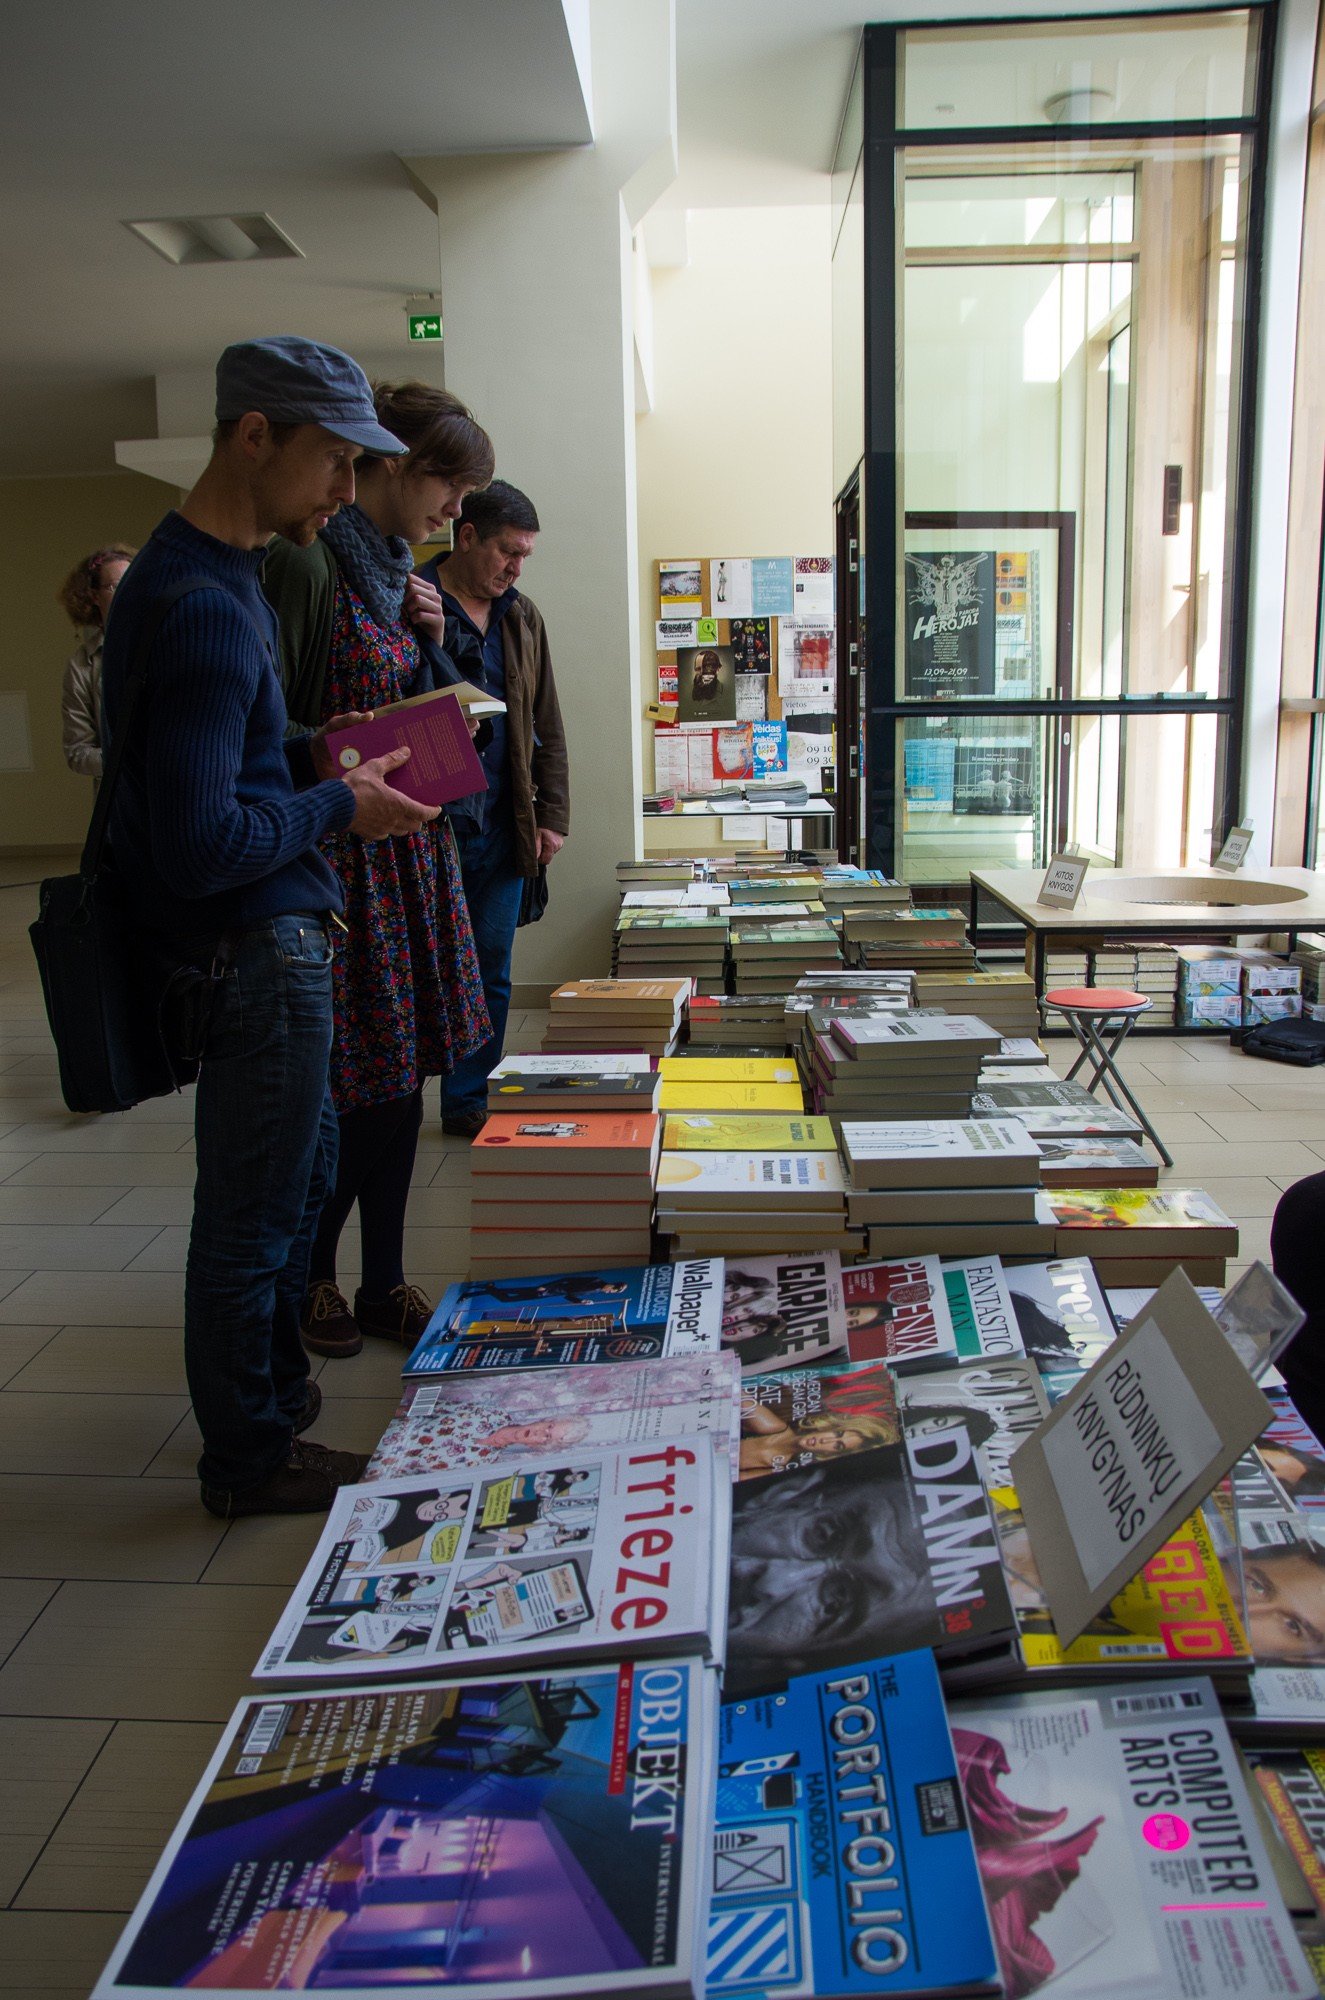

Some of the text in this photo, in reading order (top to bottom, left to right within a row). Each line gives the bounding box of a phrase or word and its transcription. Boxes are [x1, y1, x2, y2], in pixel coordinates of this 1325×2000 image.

[912, 612, 980, 641] HEROJAI
[806, 746, 820, 754] 09
[806, 757, 820, 765] 09
[1048, 880, 1075, 893] KNYGOS
[1055, 870, 1074, 881] KITOS
[651, 1265, 673, 1318] OPEN HOUSE
[777, 1262, 830, 1357] GARAGE
[946, 1292, 973, 1331] MAN
[967, 1265, 1014, 1353] FANTASTIC
[760, 1374, 781, 1406] KATE
[791, 1371, 807, 1421] DREAM GIRL
[804, 1369, 822, 1413] AMERICAN
[1105, 1359, 1182, 1503] RŪDNINKŲ
[1073, 1391, 1145, 1543] KNYGYNAS
[610, 1446, 696, 1631] frieze
[314, 1543, 349, 1604] THE FICTION ISSUE
[880, 1664, 899, 1699] THE
[299, 1703, 318, 1738] PARIS
[309, 1701, 347, 1788] RIJKSMUSEUM
[341, 1699, 375, 1785] DONALD JUDD
[360, 1697, 396, 1794] MARINA DEL REY
[405, 1695, 426, 1744] MILANO
[631, 1668, 683, 1834] OBJEKT
[1119, 1737, 1181, 1808] ARTS
[805, 1771, 832, 1880] HANDBOOK
[824, 1674, 909, 1976] PORTFOLIO
[1168, 1729, 1260, 1895] COMPUTER
[210, 1861, 258, 1955] POWERHOUSE
[269, 1861, 294, 1909] CARBON
[652, 1843, 672, 1967] INTERNATIONAL
[240, 1898, 270, 1949] YACHT
